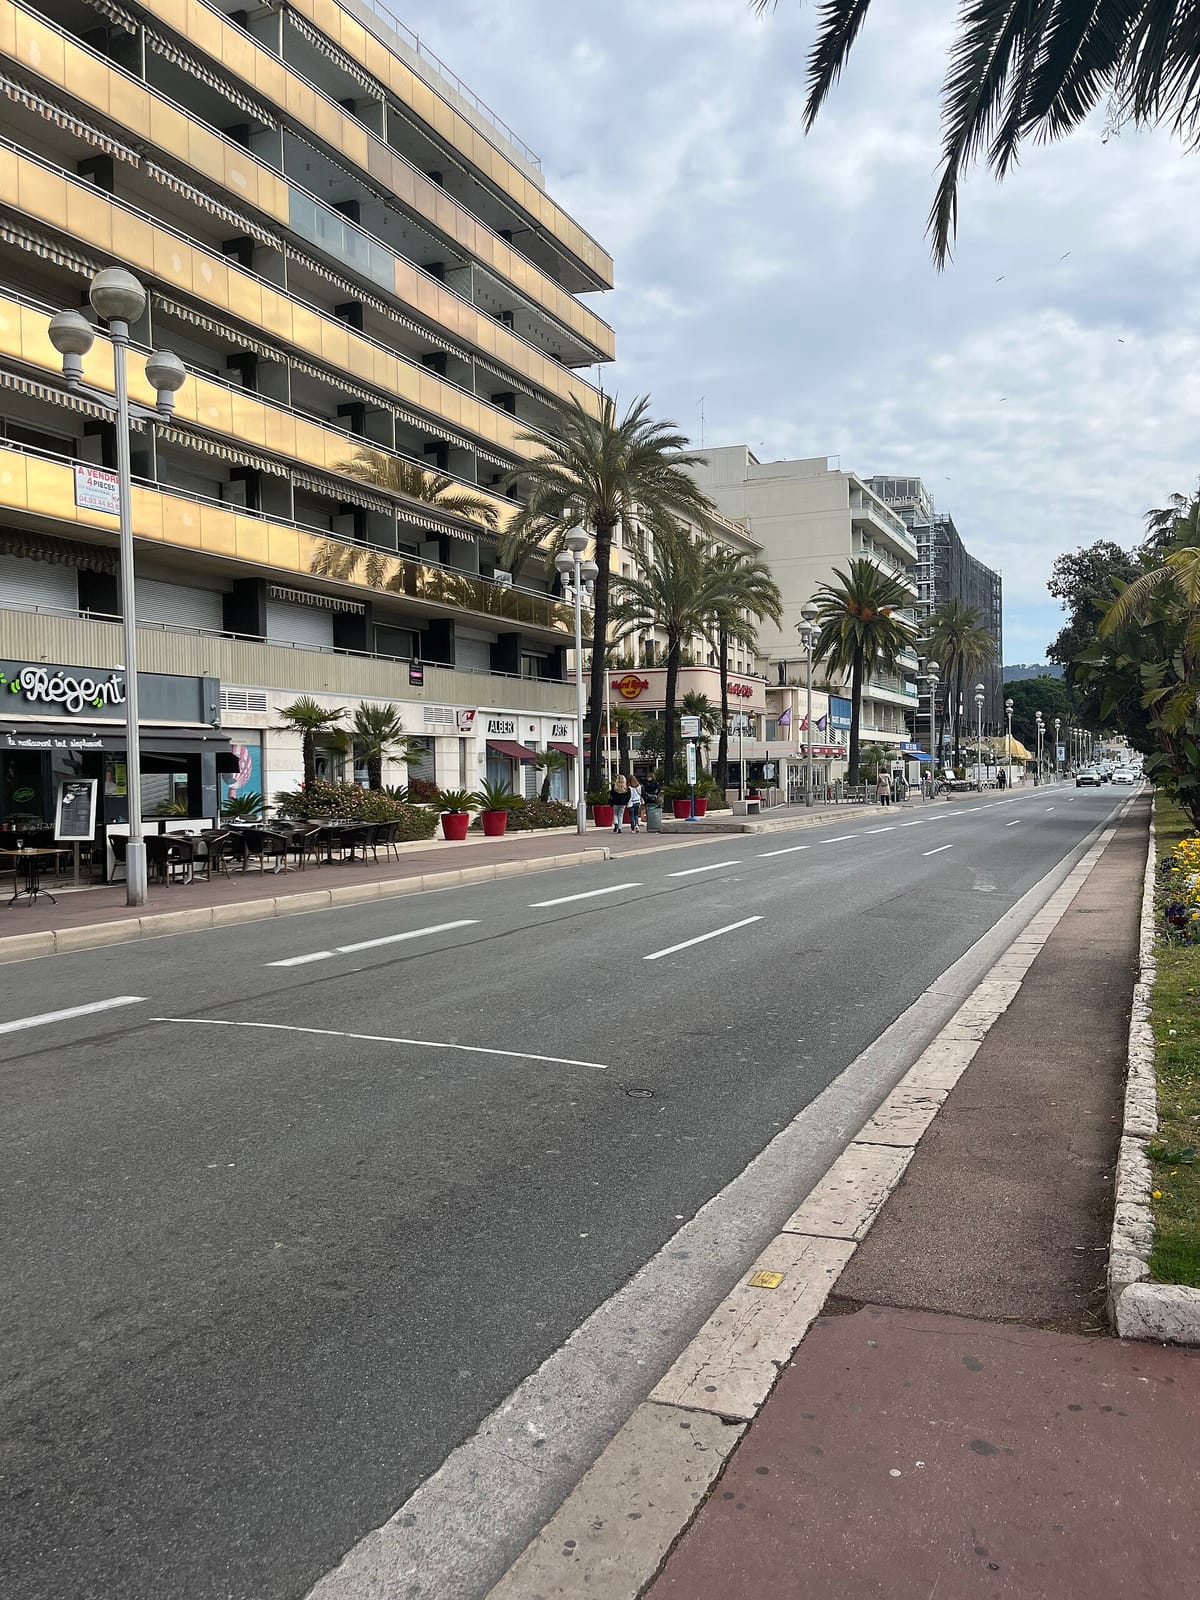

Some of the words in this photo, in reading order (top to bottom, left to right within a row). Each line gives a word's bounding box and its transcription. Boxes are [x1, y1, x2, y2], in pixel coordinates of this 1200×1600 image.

[87, 468, 120, 484] VENDRE
[93, 480, 116, 492] PIECES
[20, 666, 126, 713] Régent
